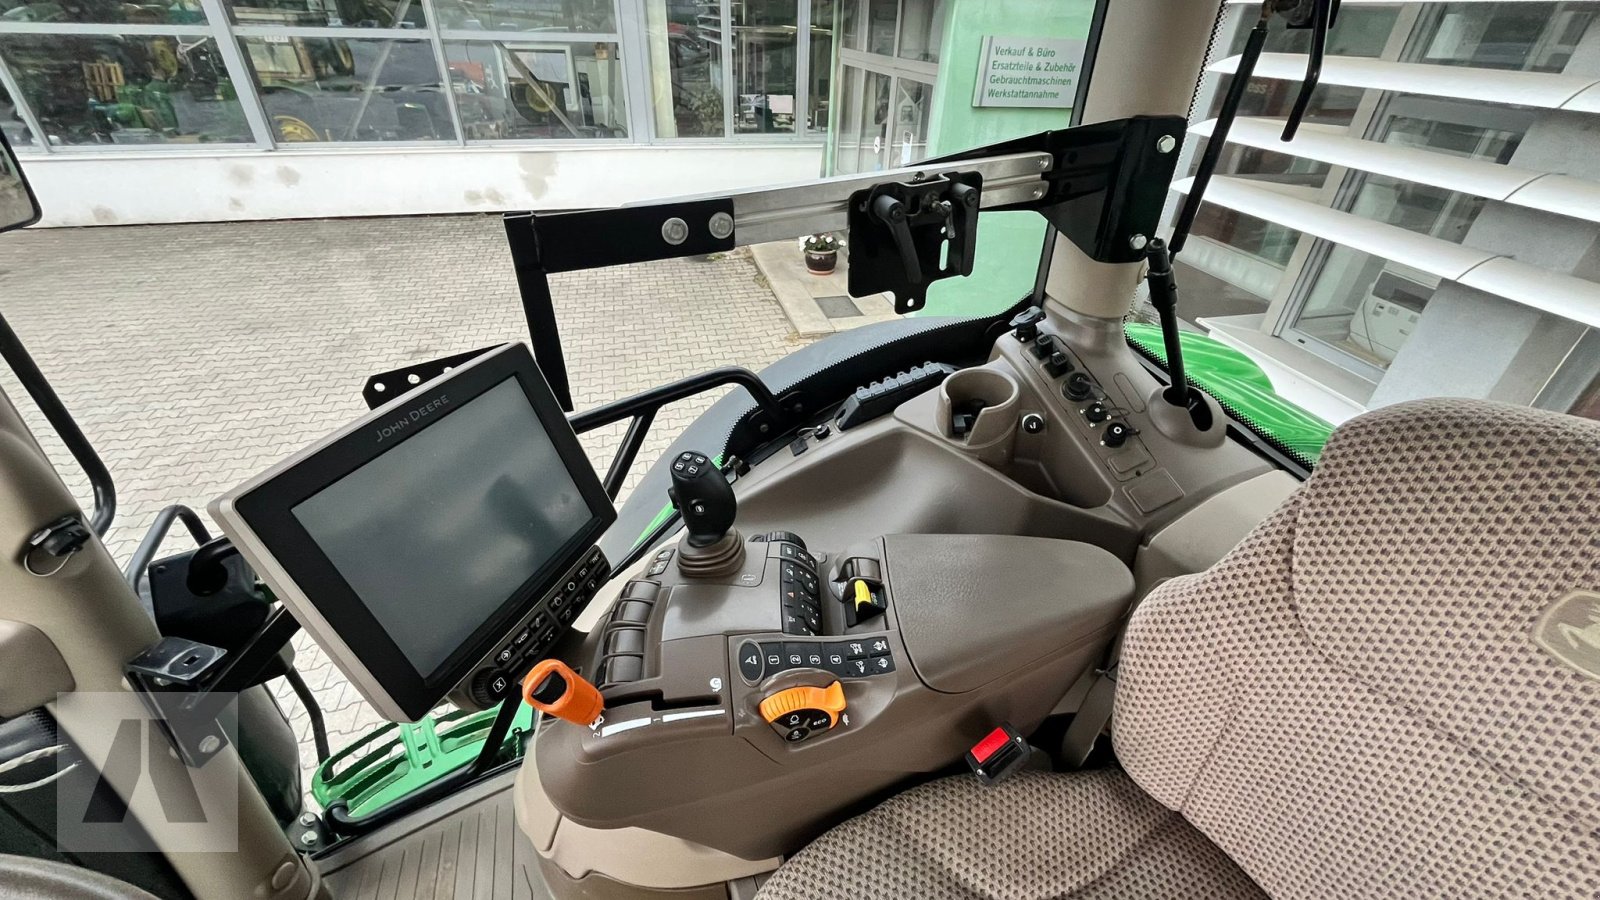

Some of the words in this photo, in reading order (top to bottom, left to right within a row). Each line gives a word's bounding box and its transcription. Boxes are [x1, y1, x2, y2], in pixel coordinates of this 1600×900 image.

[995, 46, 1026, 57] Verkauf
[1028, 47, 1034, 57] &
[1036, 47, 1056, 57] Büro
[992, 60, 1034, 71] Ersatzteile
[1035, 62, 1041, 71] &
[1044, 62, 1076, 72] Zubehör
[989, 75, 1072, 85] Gebrauchtmaschinen
[987, 88, 1059, 99] Werkstattannahme
[376, 417, 410, 442] JOHN
[408, 394, 450, 421] DEERE
[813, 718, 827, 726] eco
